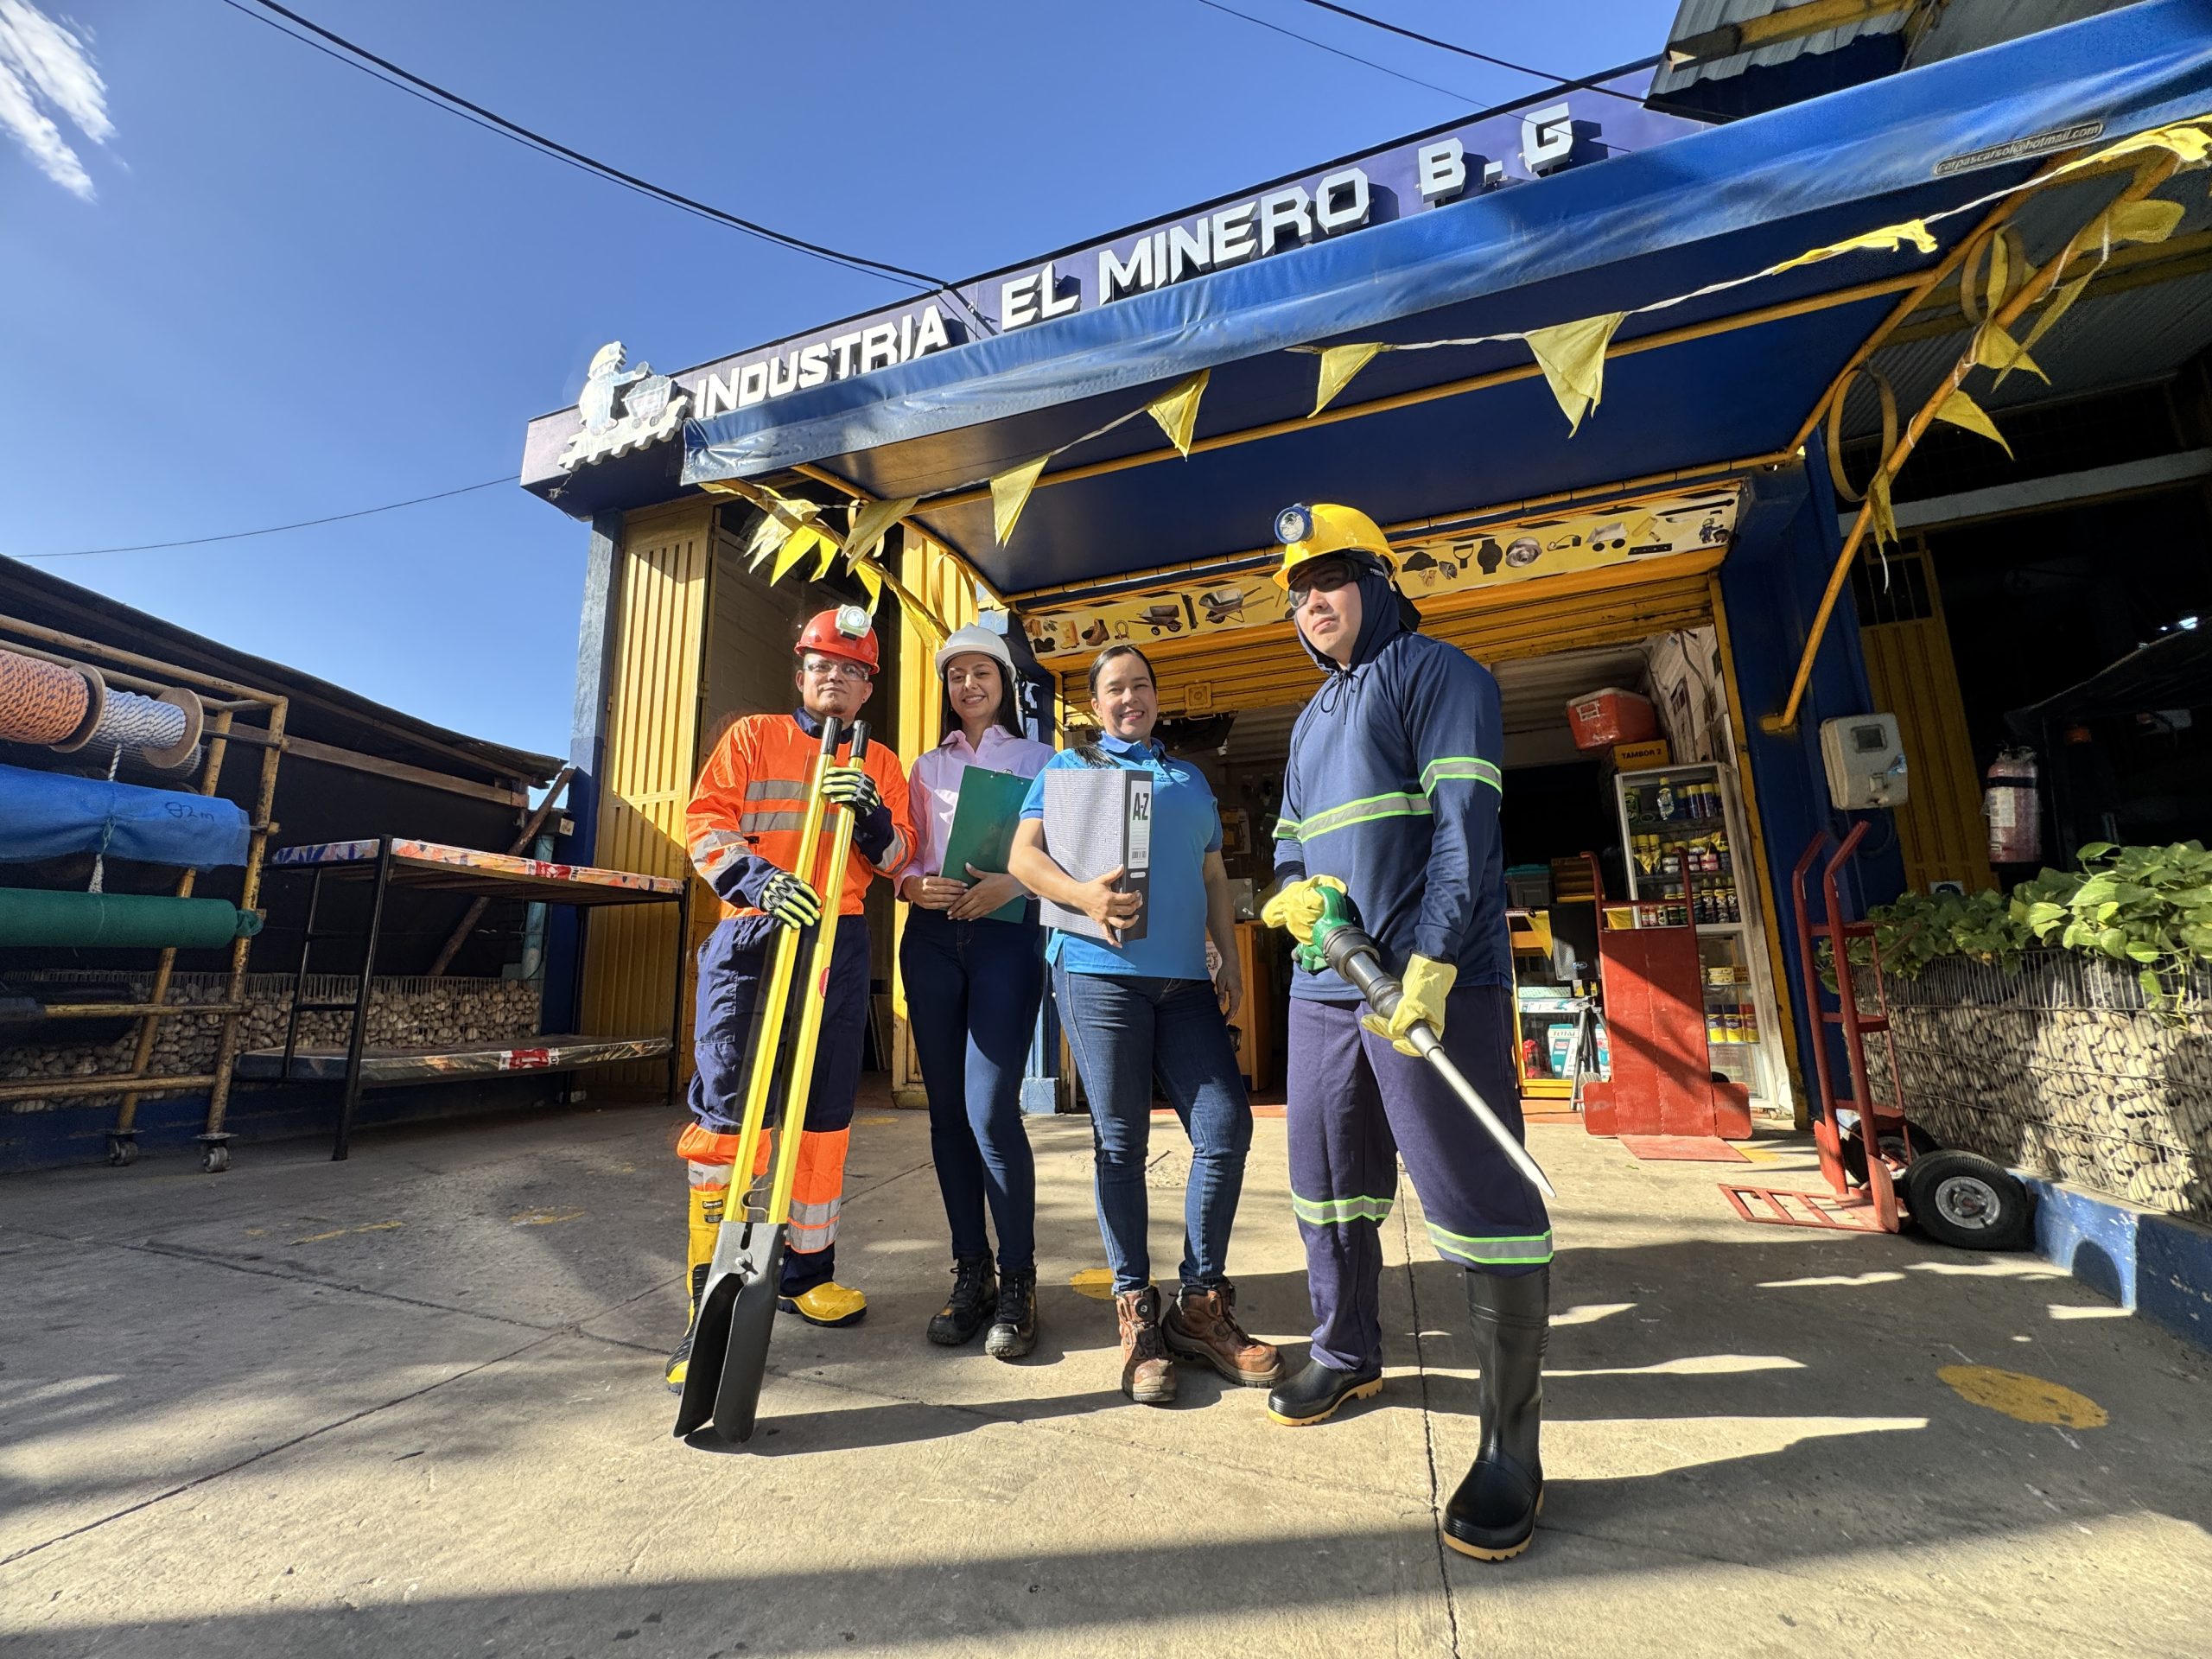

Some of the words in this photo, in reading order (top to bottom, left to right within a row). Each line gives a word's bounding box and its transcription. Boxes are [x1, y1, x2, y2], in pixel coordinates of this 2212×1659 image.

[694, 304, 950, 418] INDUSTRIA
[1001, 261, 1080, 332] EL
[1098, 167, 1370, 306] MINERO
[1621, 748, 1656, 760] TAMBOR
[1132, 791, 1150, 821] A-Z
